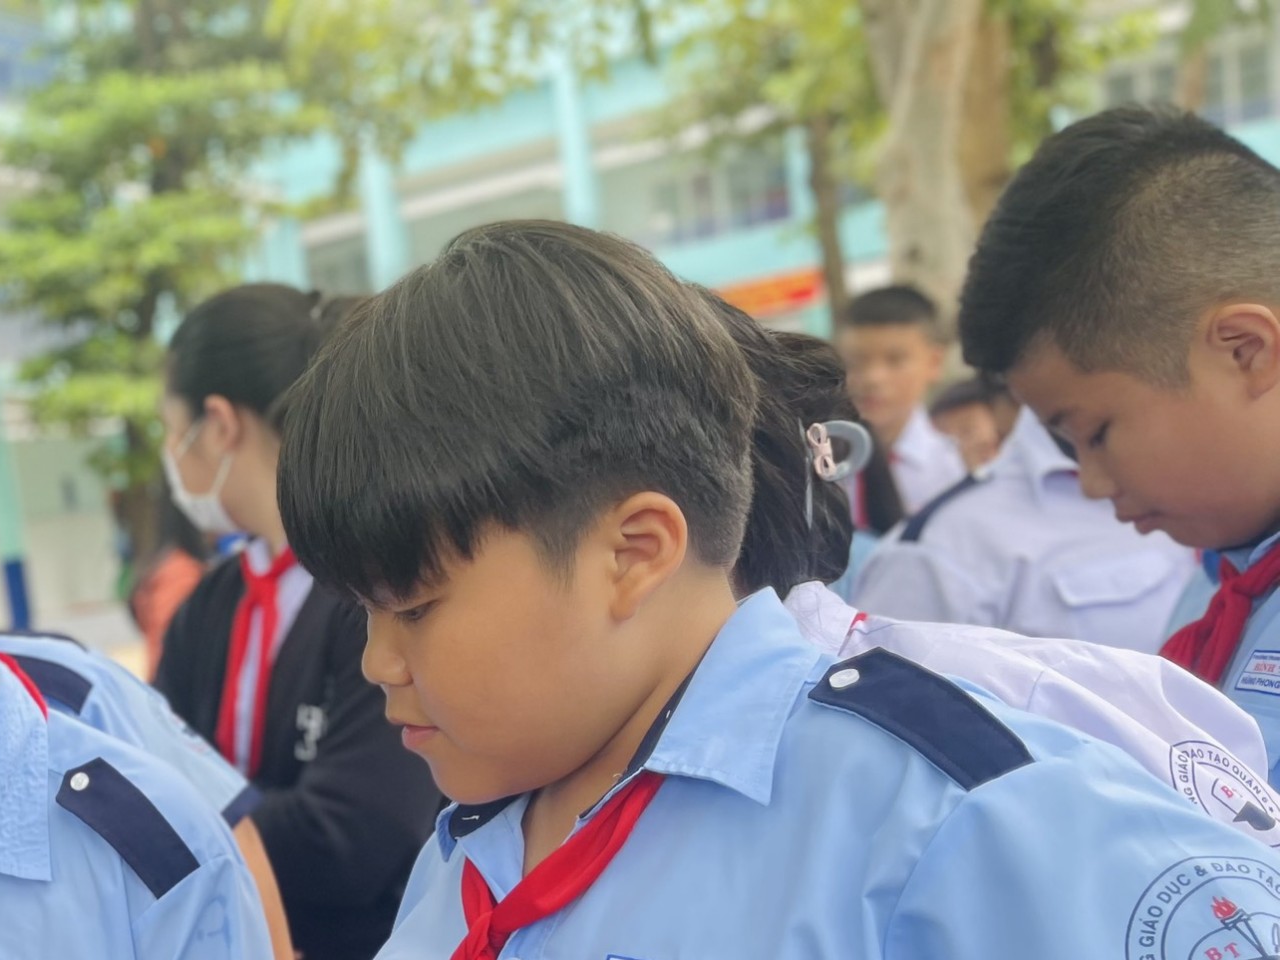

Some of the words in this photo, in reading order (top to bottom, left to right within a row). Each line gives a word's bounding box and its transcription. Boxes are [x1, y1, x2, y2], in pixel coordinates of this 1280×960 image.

[1138, 904, 1164, 948] GIÁO
[1156, 873, 1191, 904] DỤC
[1193, 864, 1209, 877] &
